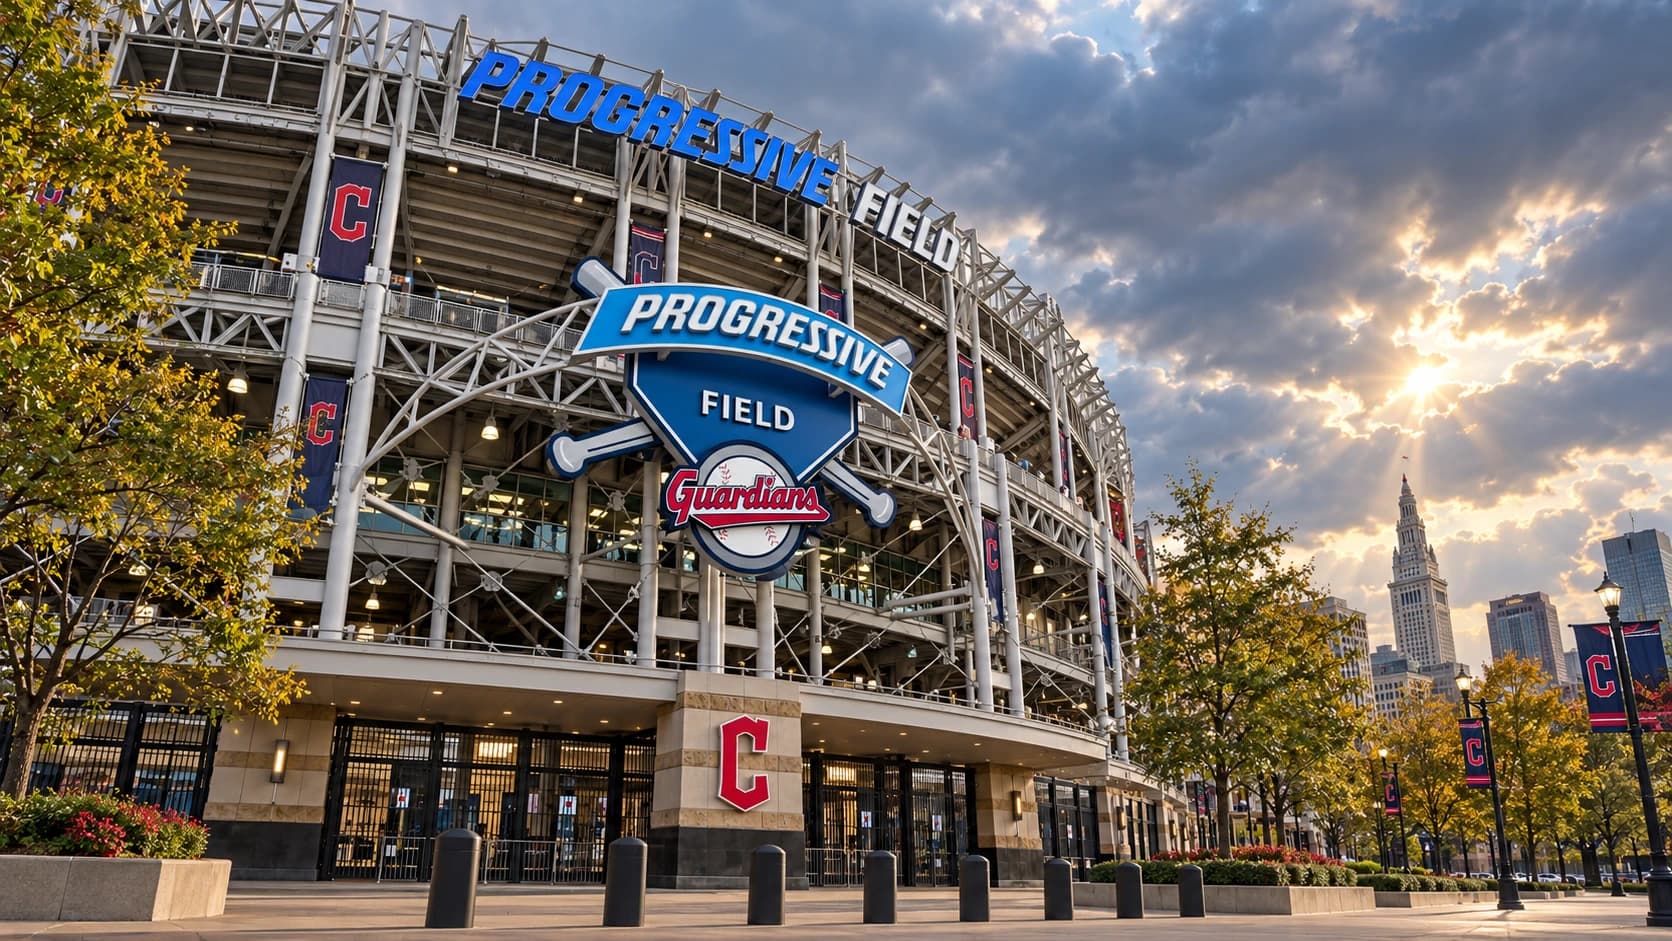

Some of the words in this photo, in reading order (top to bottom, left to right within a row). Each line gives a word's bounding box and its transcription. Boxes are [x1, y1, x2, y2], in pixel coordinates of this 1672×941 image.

[458, 52, 839, 207] PROGRESSIVE
[849, 181, 960, 272] FIELD
[329, 183, 371, 242] C
[620, 293, 894, 389] PROGRESSIVE
[701, 389, 796, 431] FIELD
[960, 375, 975, 418] C
[307, 401, 336, 446] C
[666, 469, 820, 526] Guardians
[986, 537, 999, 571] C
[1585, 655, 1616, 698] C
[718, 714, 771, 812] C
[1466, 738, 1484, 767] C
[1385, 783, 1396, 802] C
